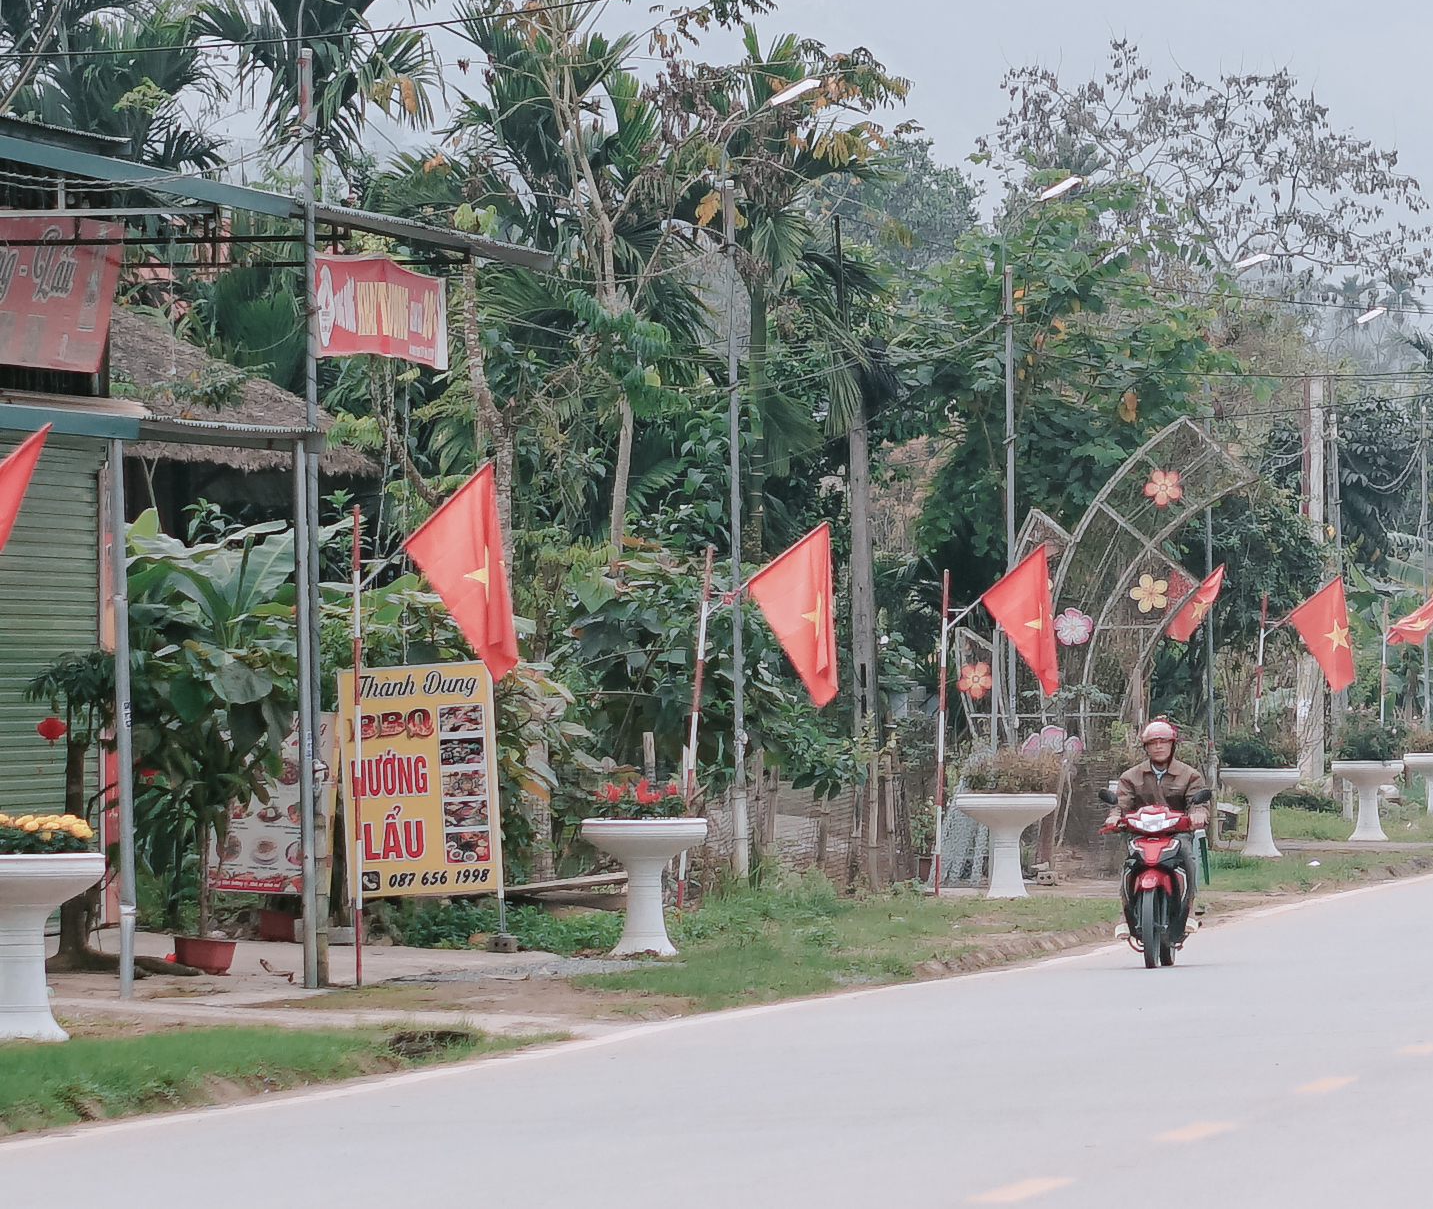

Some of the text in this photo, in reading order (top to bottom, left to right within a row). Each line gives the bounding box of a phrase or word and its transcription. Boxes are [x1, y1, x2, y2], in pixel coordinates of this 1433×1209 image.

[347, 708, 434, 743] BBQ
[363, 805, 425, 860] LẨU
[388, 868, 490, 888] 087 656 1998
